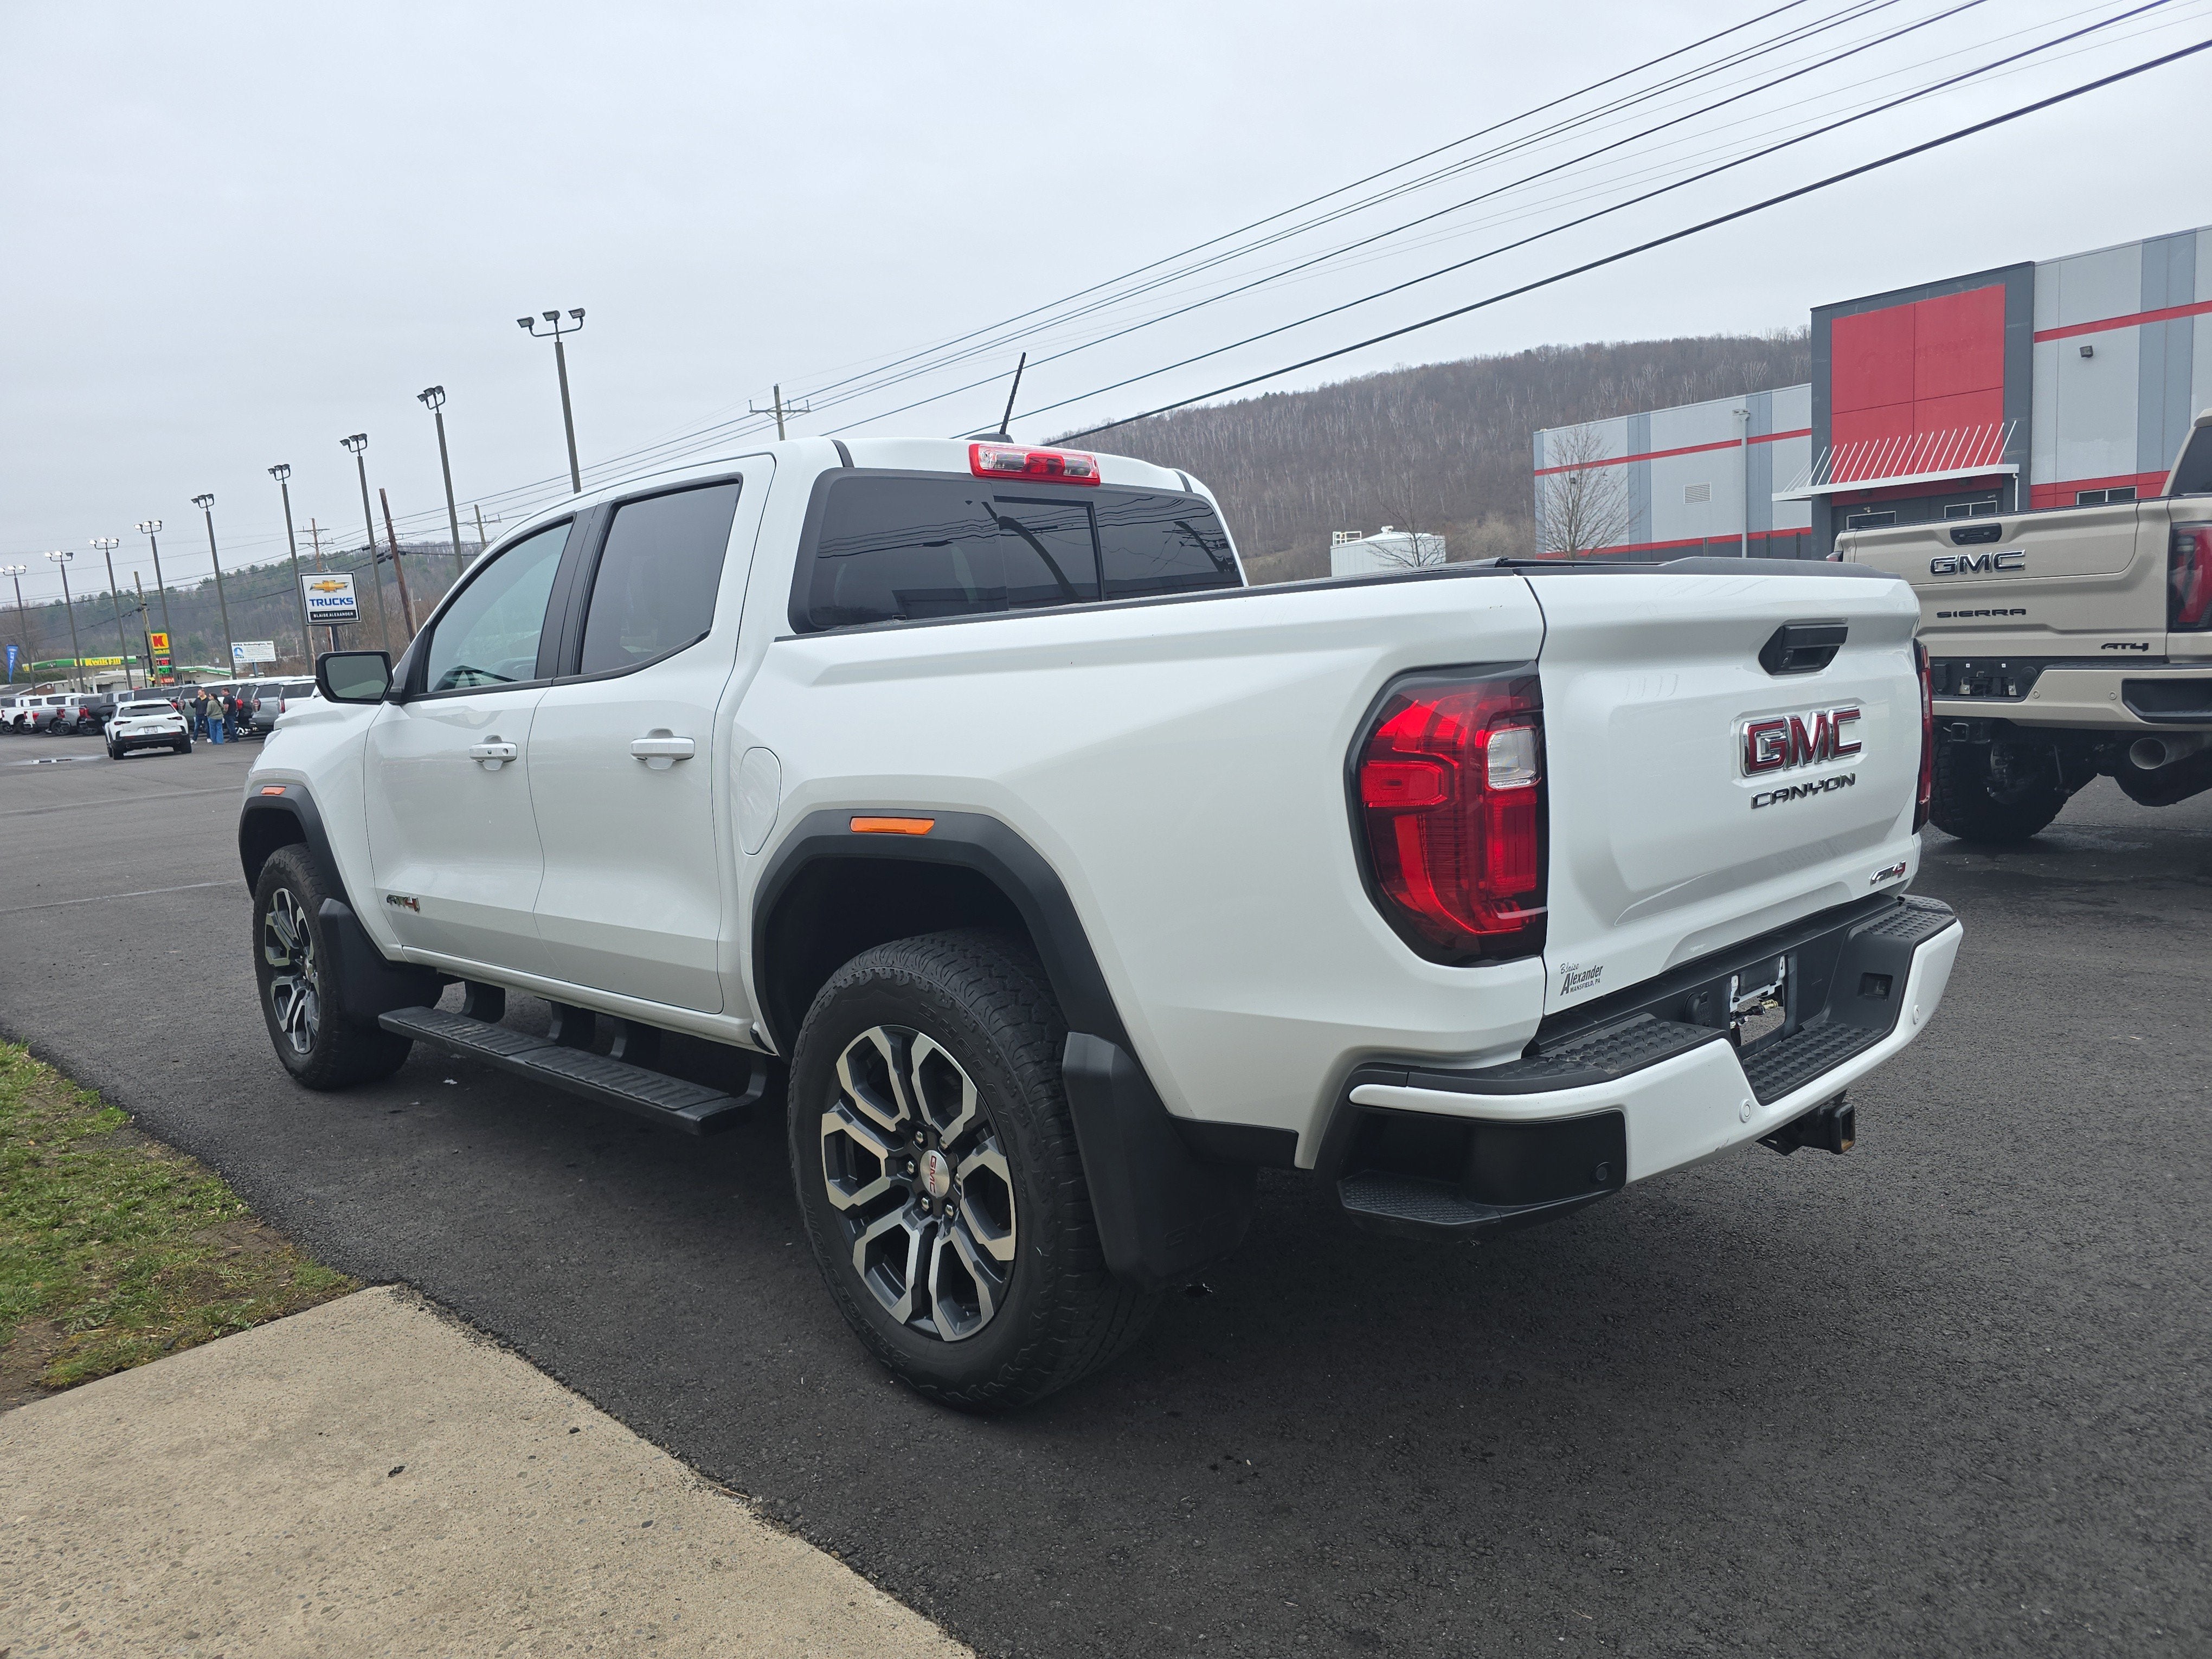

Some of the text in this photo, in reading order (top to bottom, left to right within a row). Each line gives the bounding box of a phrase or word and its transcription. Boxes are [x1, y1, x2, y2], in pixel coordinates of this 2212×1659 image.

[1930, 549, 2025, 575] GMC
[309, 597, 353, 607] TRUCKS
[1936, 608, 2026, 618] SIERRA
[2101, 642, 2149, 652] AT4
[1740, 706, 1862, 777] GMC
[1751, 772, 1856, 809] CANYON
[1560, 962, 1579, 974] Blaise
[1560, 964, 1604, 996] Alexander
[1570, 981, 1594, 993] MANSFIELD,
